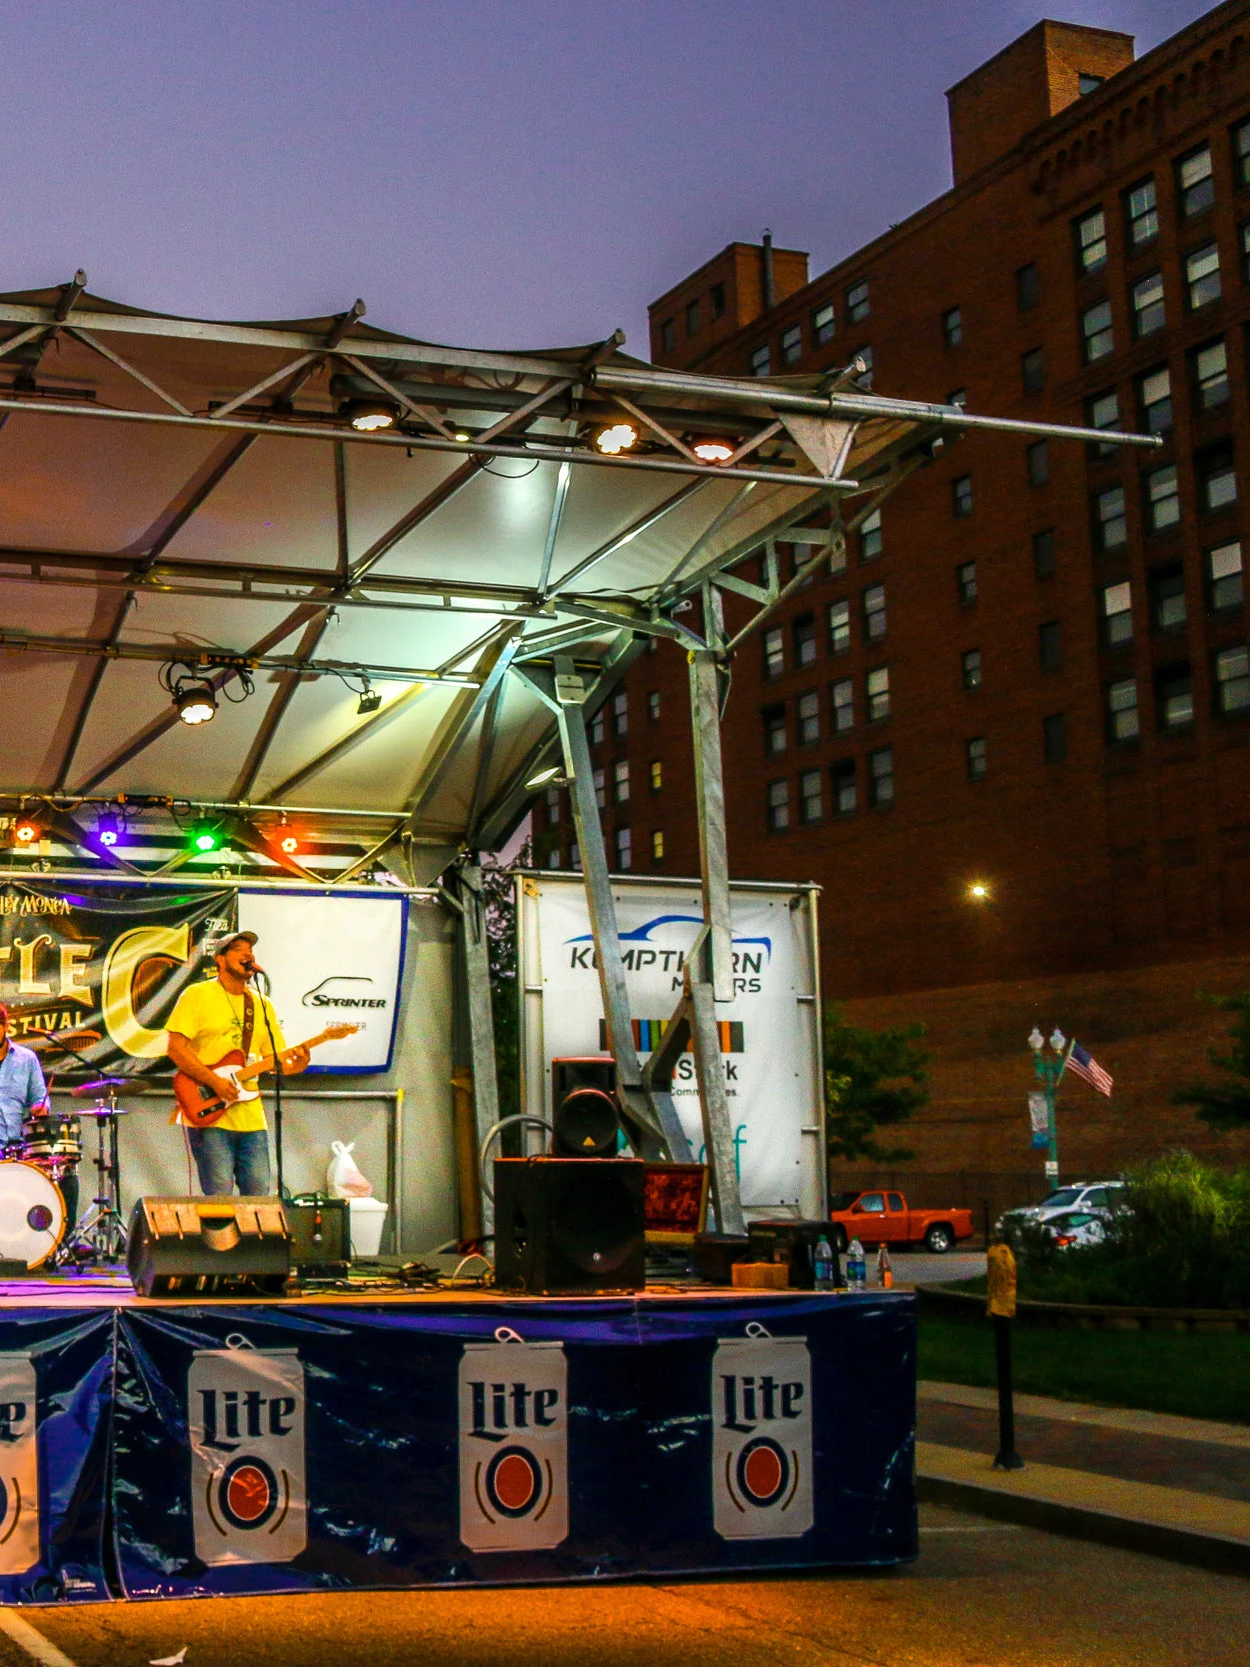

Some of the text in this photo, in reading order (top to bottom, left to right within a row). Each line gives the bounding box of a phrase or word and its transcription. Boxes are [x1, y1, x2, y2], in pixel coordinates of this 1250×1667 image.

[101, 923, 192, 1059] C
[311, 995, 387, 1008] SPRINTER
[6, 1011, 86, 1037] STIVAL
[200, 1388, 297, 1453] Lite
[467, 1381, 558, 1442] Lite
[719, 1374, 805, 1433] Lite
